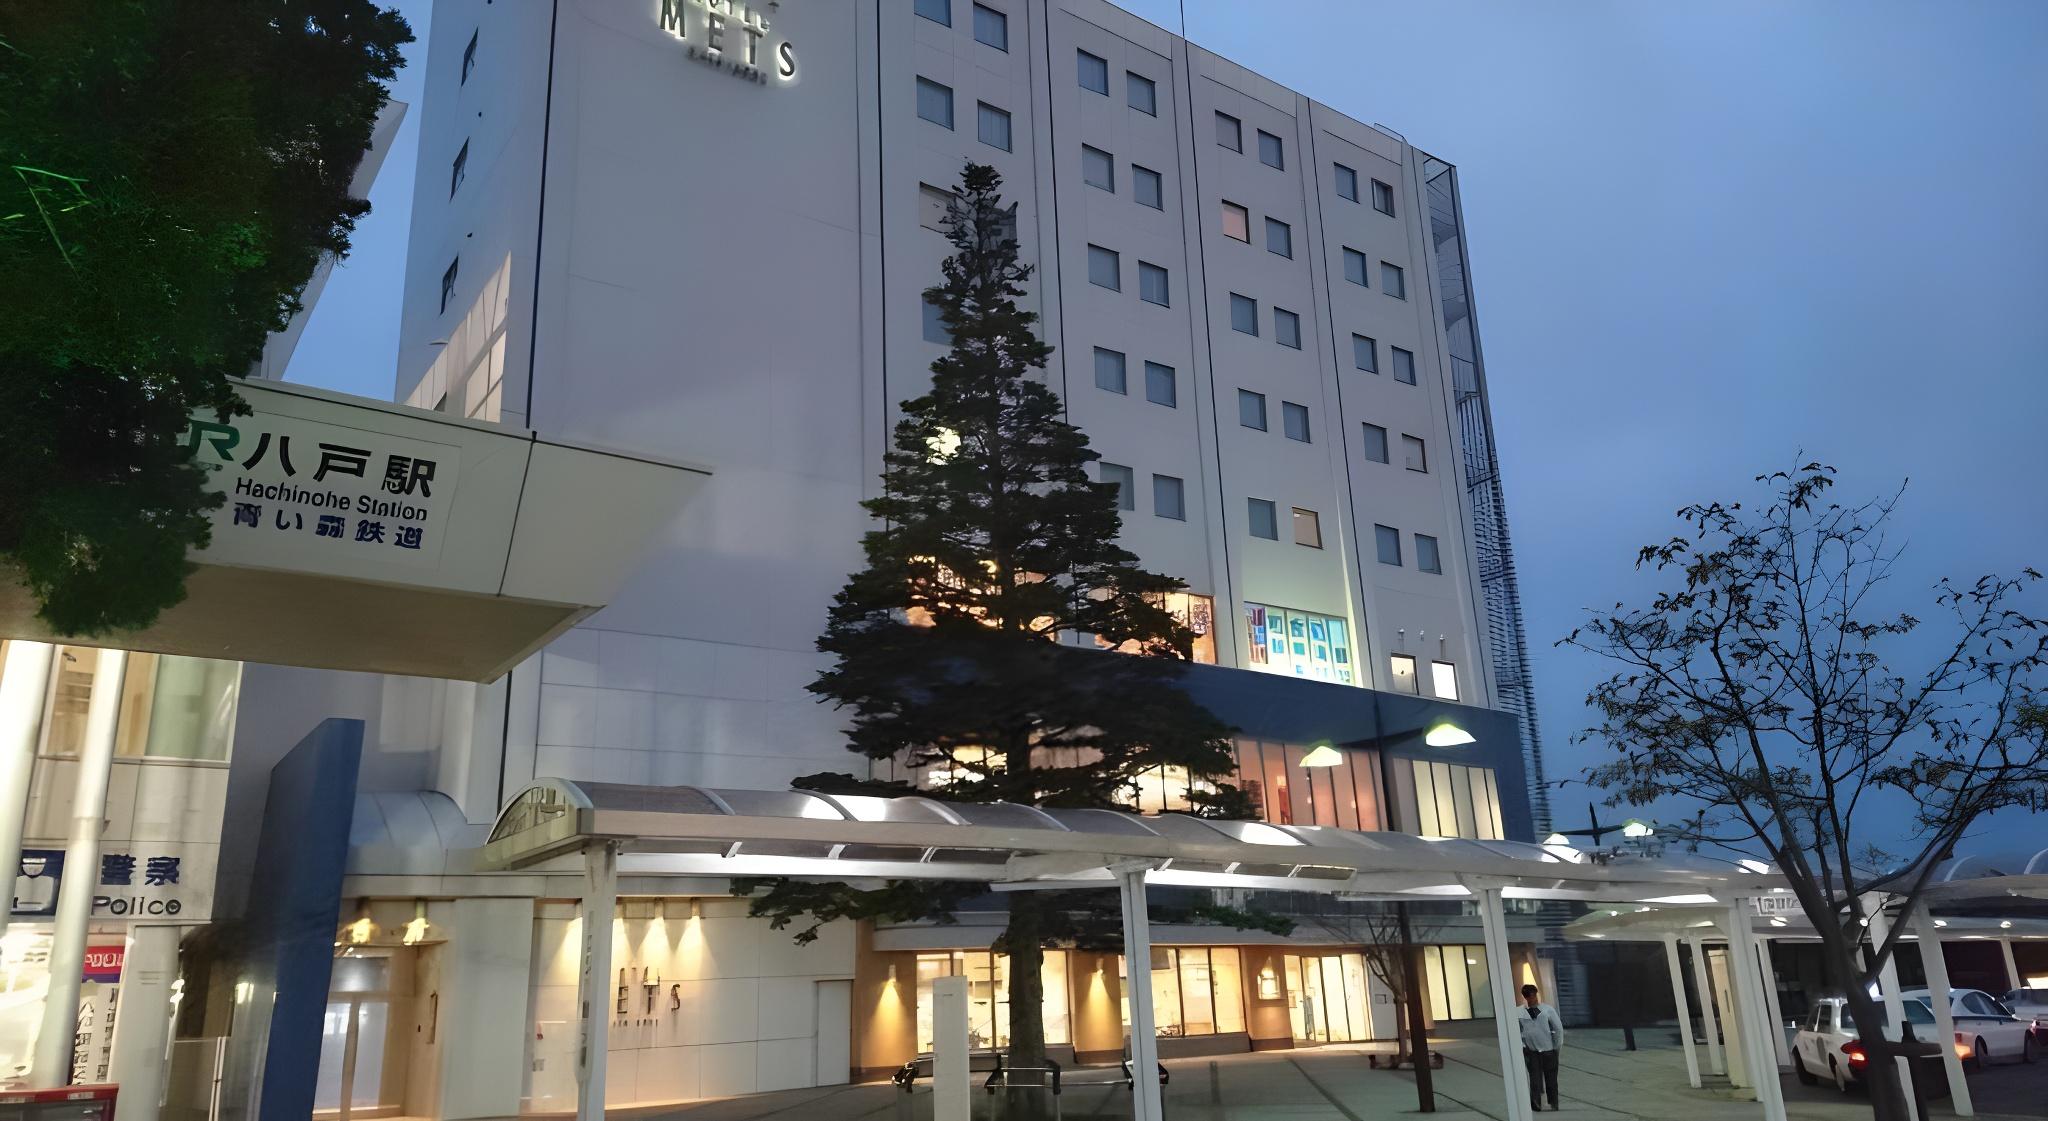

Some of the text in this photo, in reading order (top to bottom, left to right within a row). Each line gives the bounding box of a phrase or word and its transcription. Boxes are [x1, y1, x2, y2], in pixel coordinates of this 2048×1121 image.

[660, 0, 795, 77] METS
[235, 477, 351, 510] Hachinohe
[242, 432, 437, 498] 八戸駅
